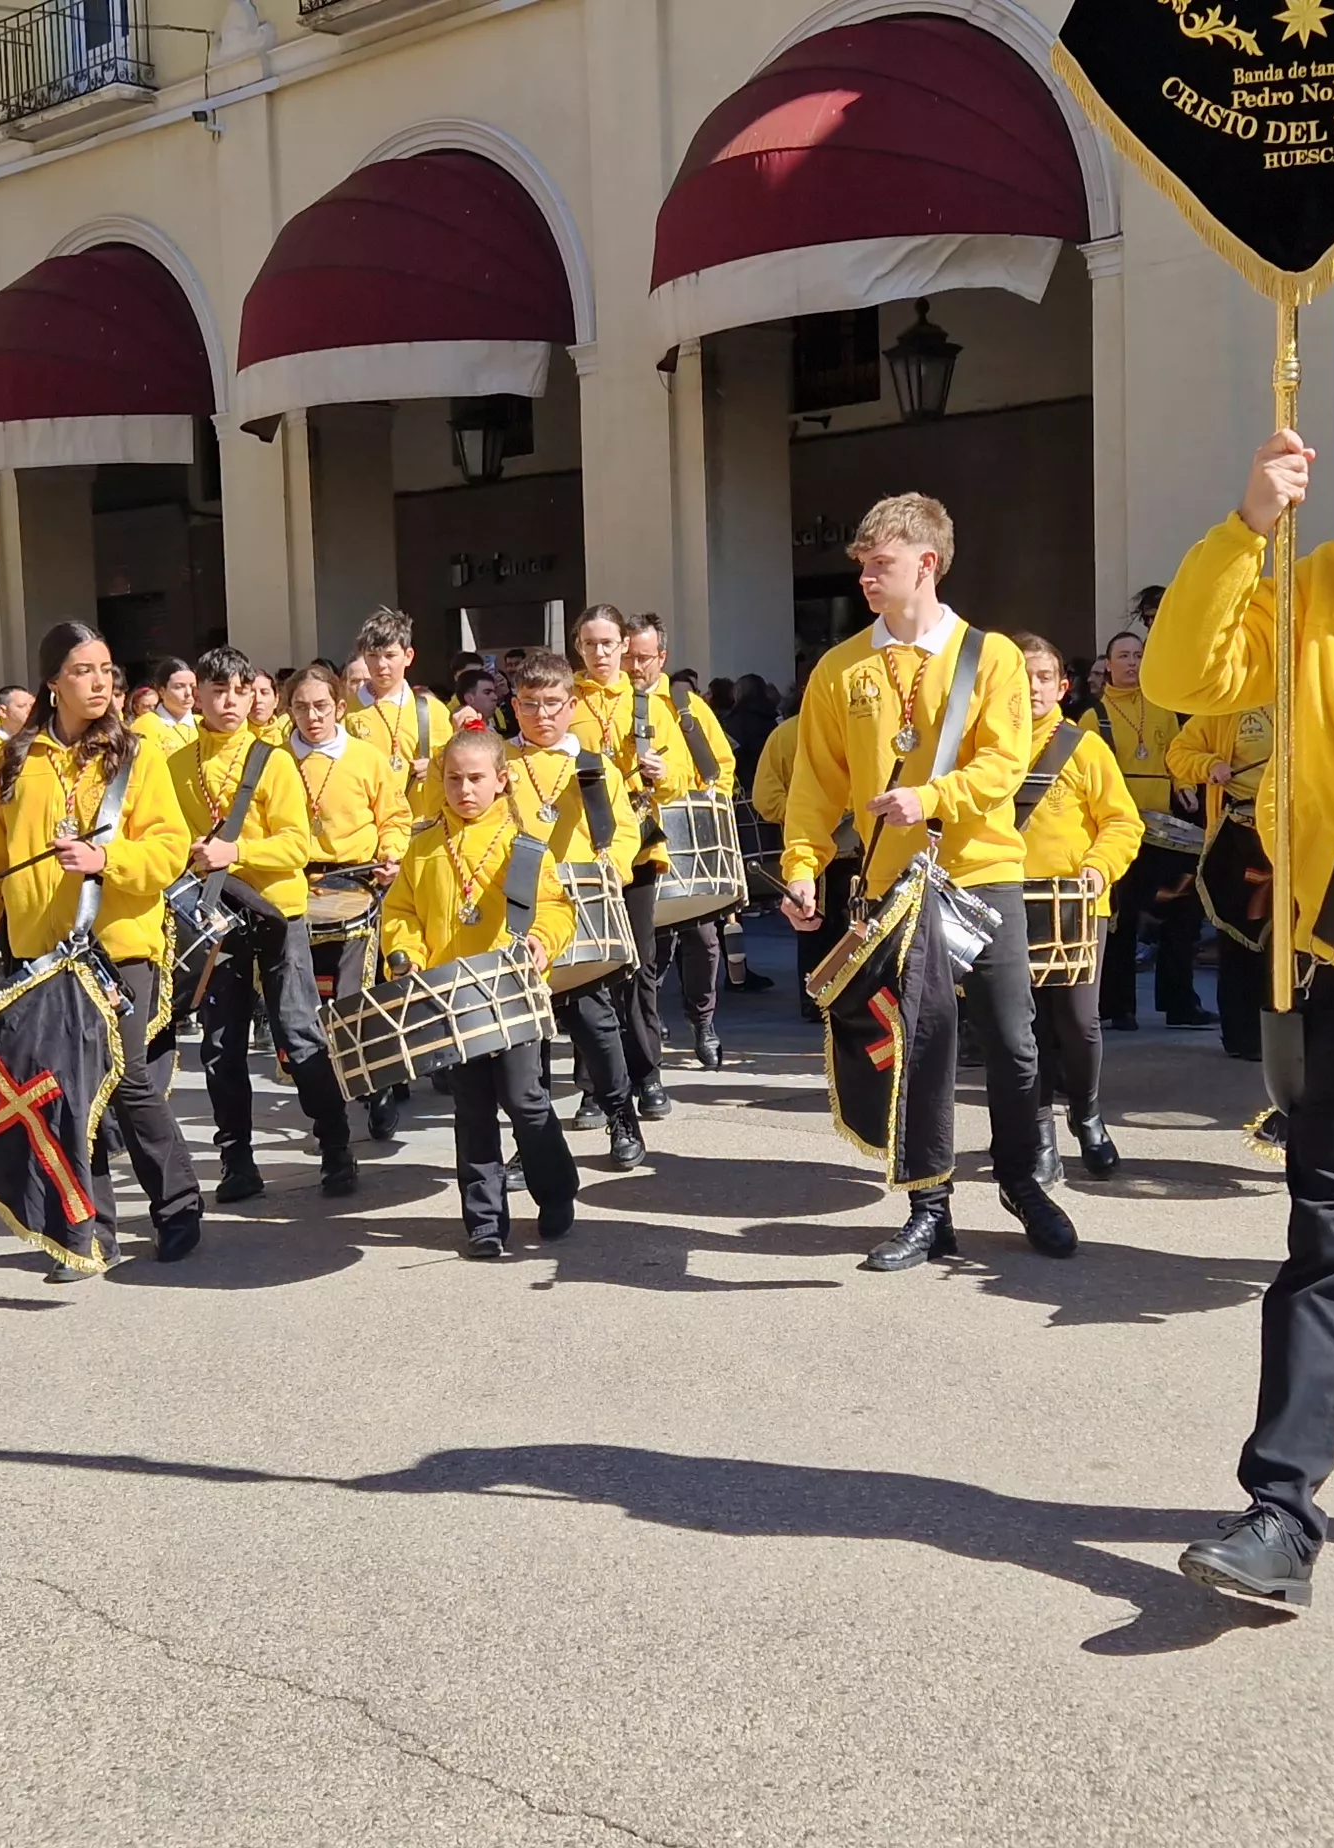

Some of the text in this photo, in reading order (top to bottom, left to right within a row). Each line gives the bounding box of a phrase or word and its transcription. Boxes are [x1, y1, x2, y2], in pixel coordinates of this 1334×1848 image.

[1232, 63, 1284, 85] Banda
[1288, 61, 1307, 79] de
[1230, 86, 1294, 109] Pedro
[1161, 76, 1258, 140] CRISTO
[1263, 119, 1327, 145] DEL
